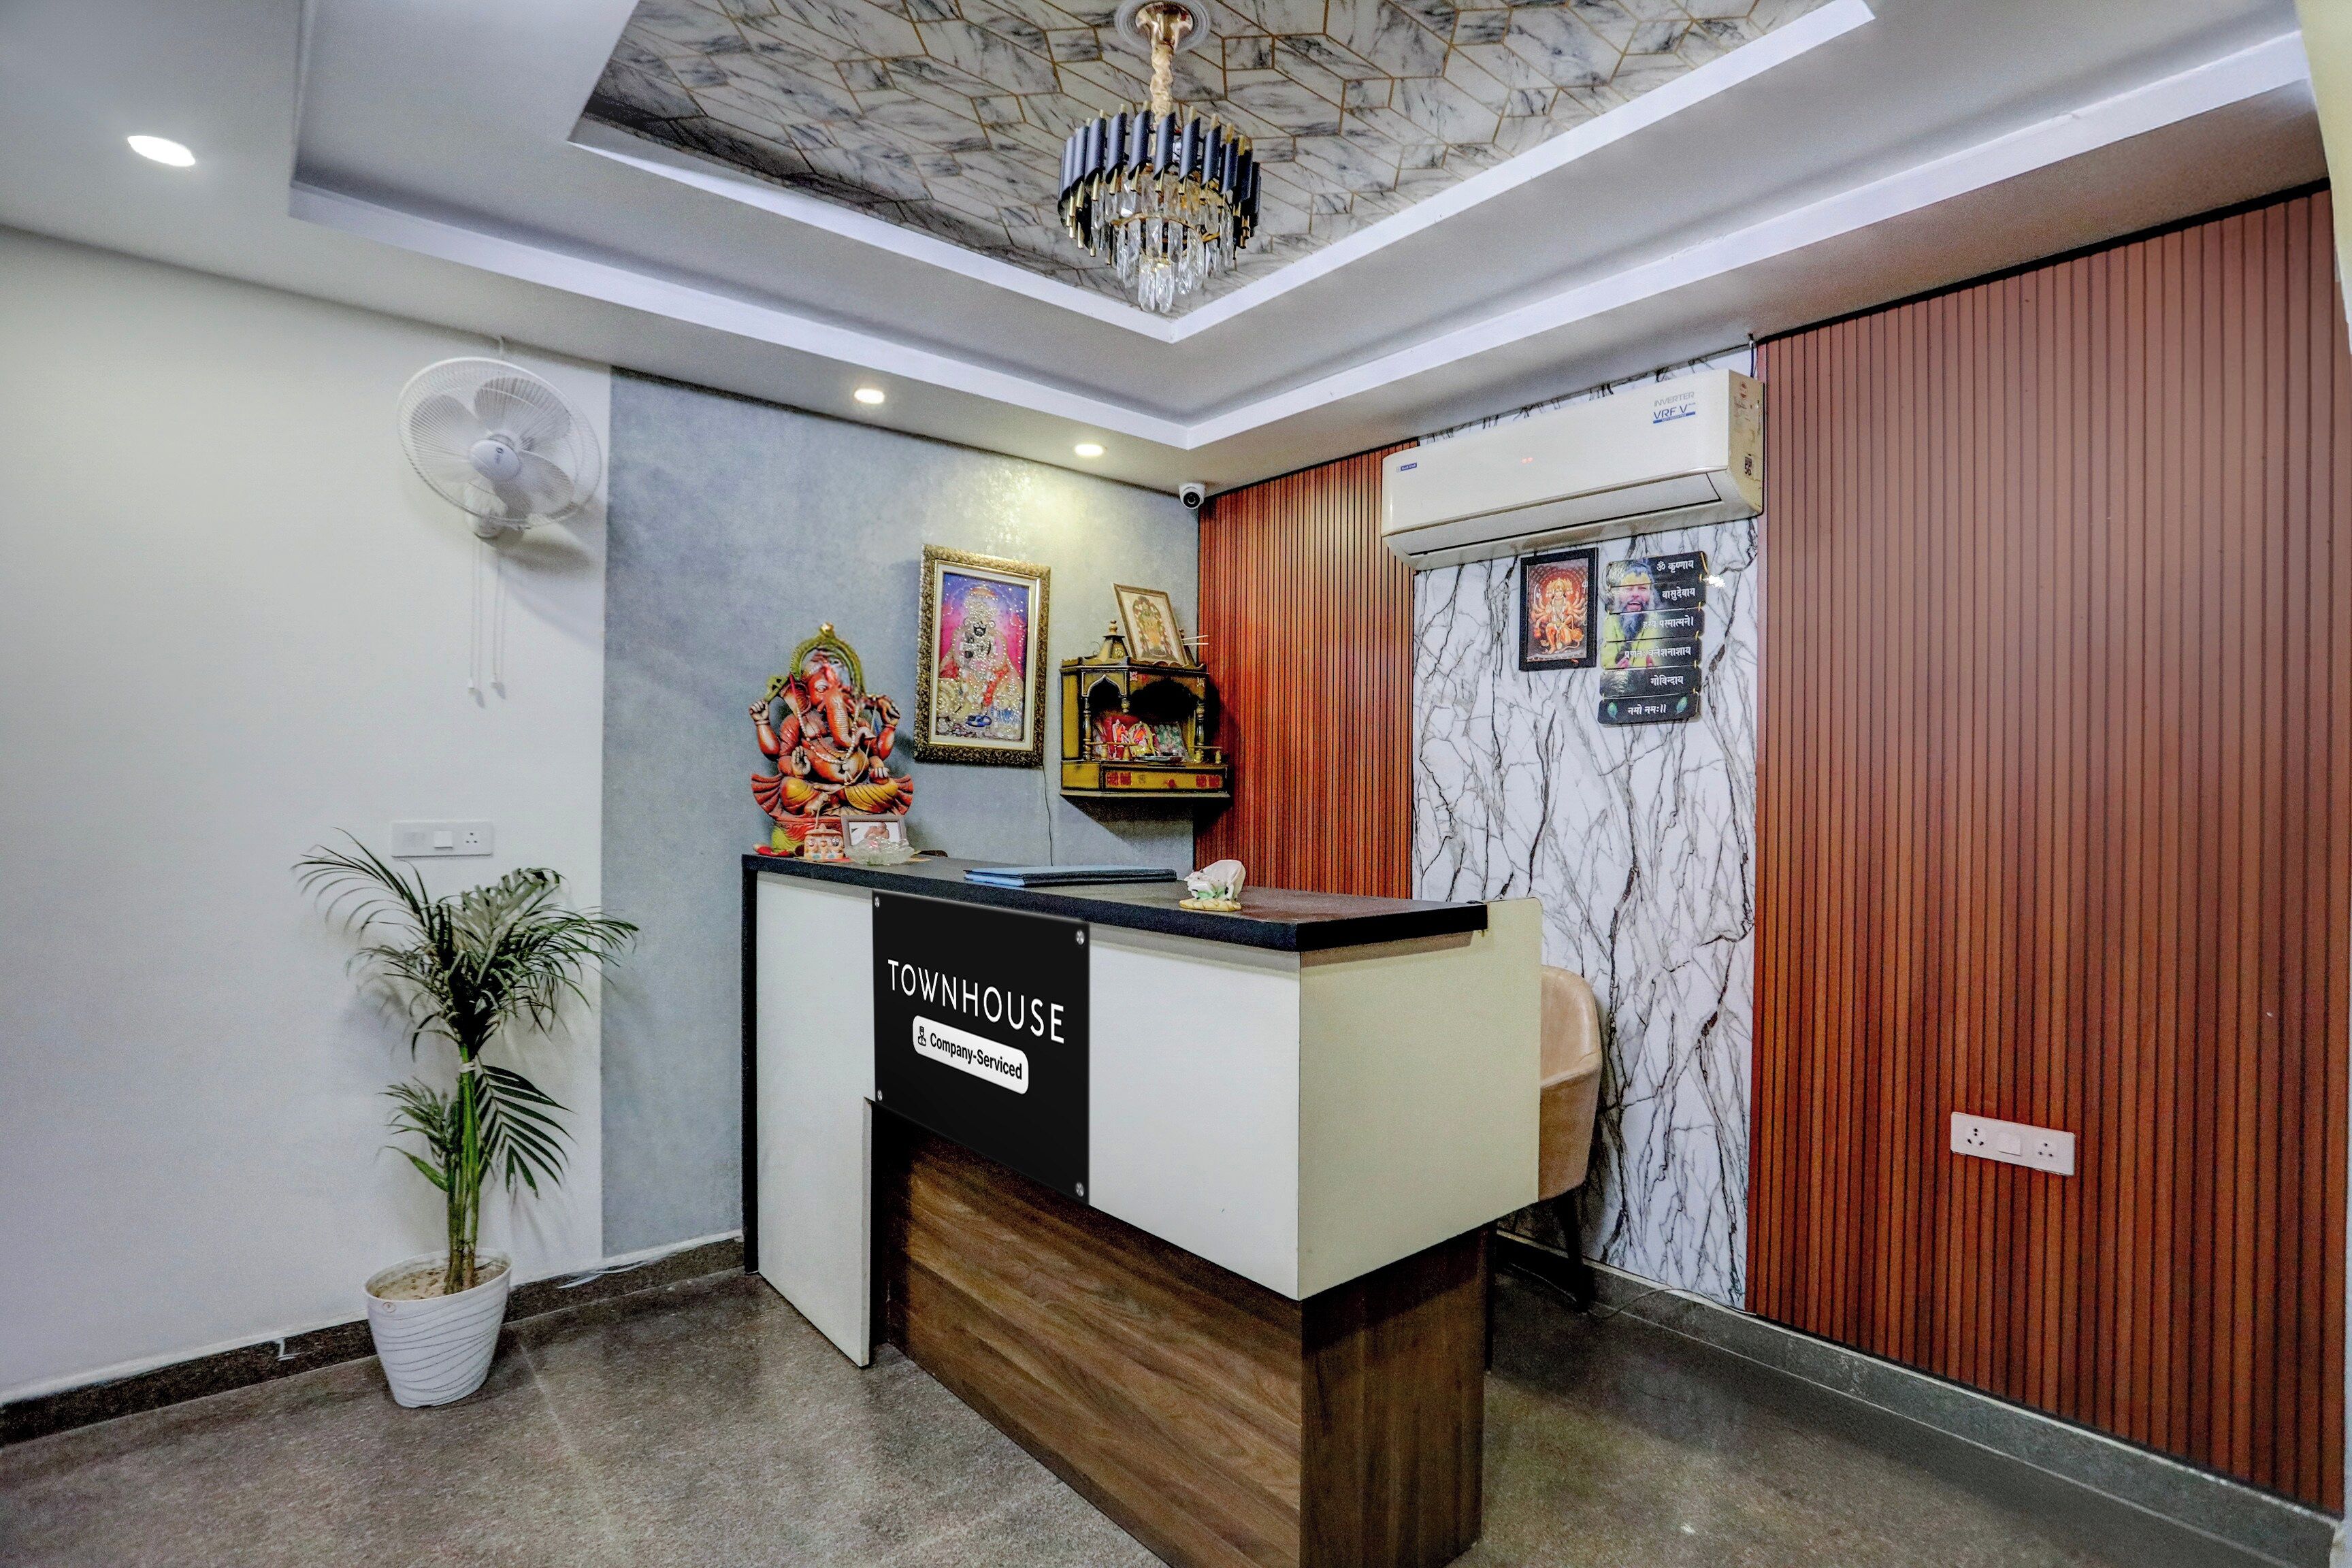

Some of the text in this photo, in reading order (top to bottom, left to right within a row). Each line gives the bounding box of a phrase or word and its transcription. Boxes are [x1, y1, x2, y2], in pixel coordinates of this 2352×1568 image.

[1654, 391, 1695, 407] INVERTER
[1653, 406, 1677, 419] VRF
[1667, 559, 1695, 574] कृष्णाय
[1662, 586, 1696, 601] वासुदेवाय
[1650, 674, 1684, 687] गोविन्दाय
[1627, 704, 1643, 715] नमो
[887, 958, 1065, 1045] TOWNHOUSE
[930, 1032, 1023, 1081] Company-Serviced
